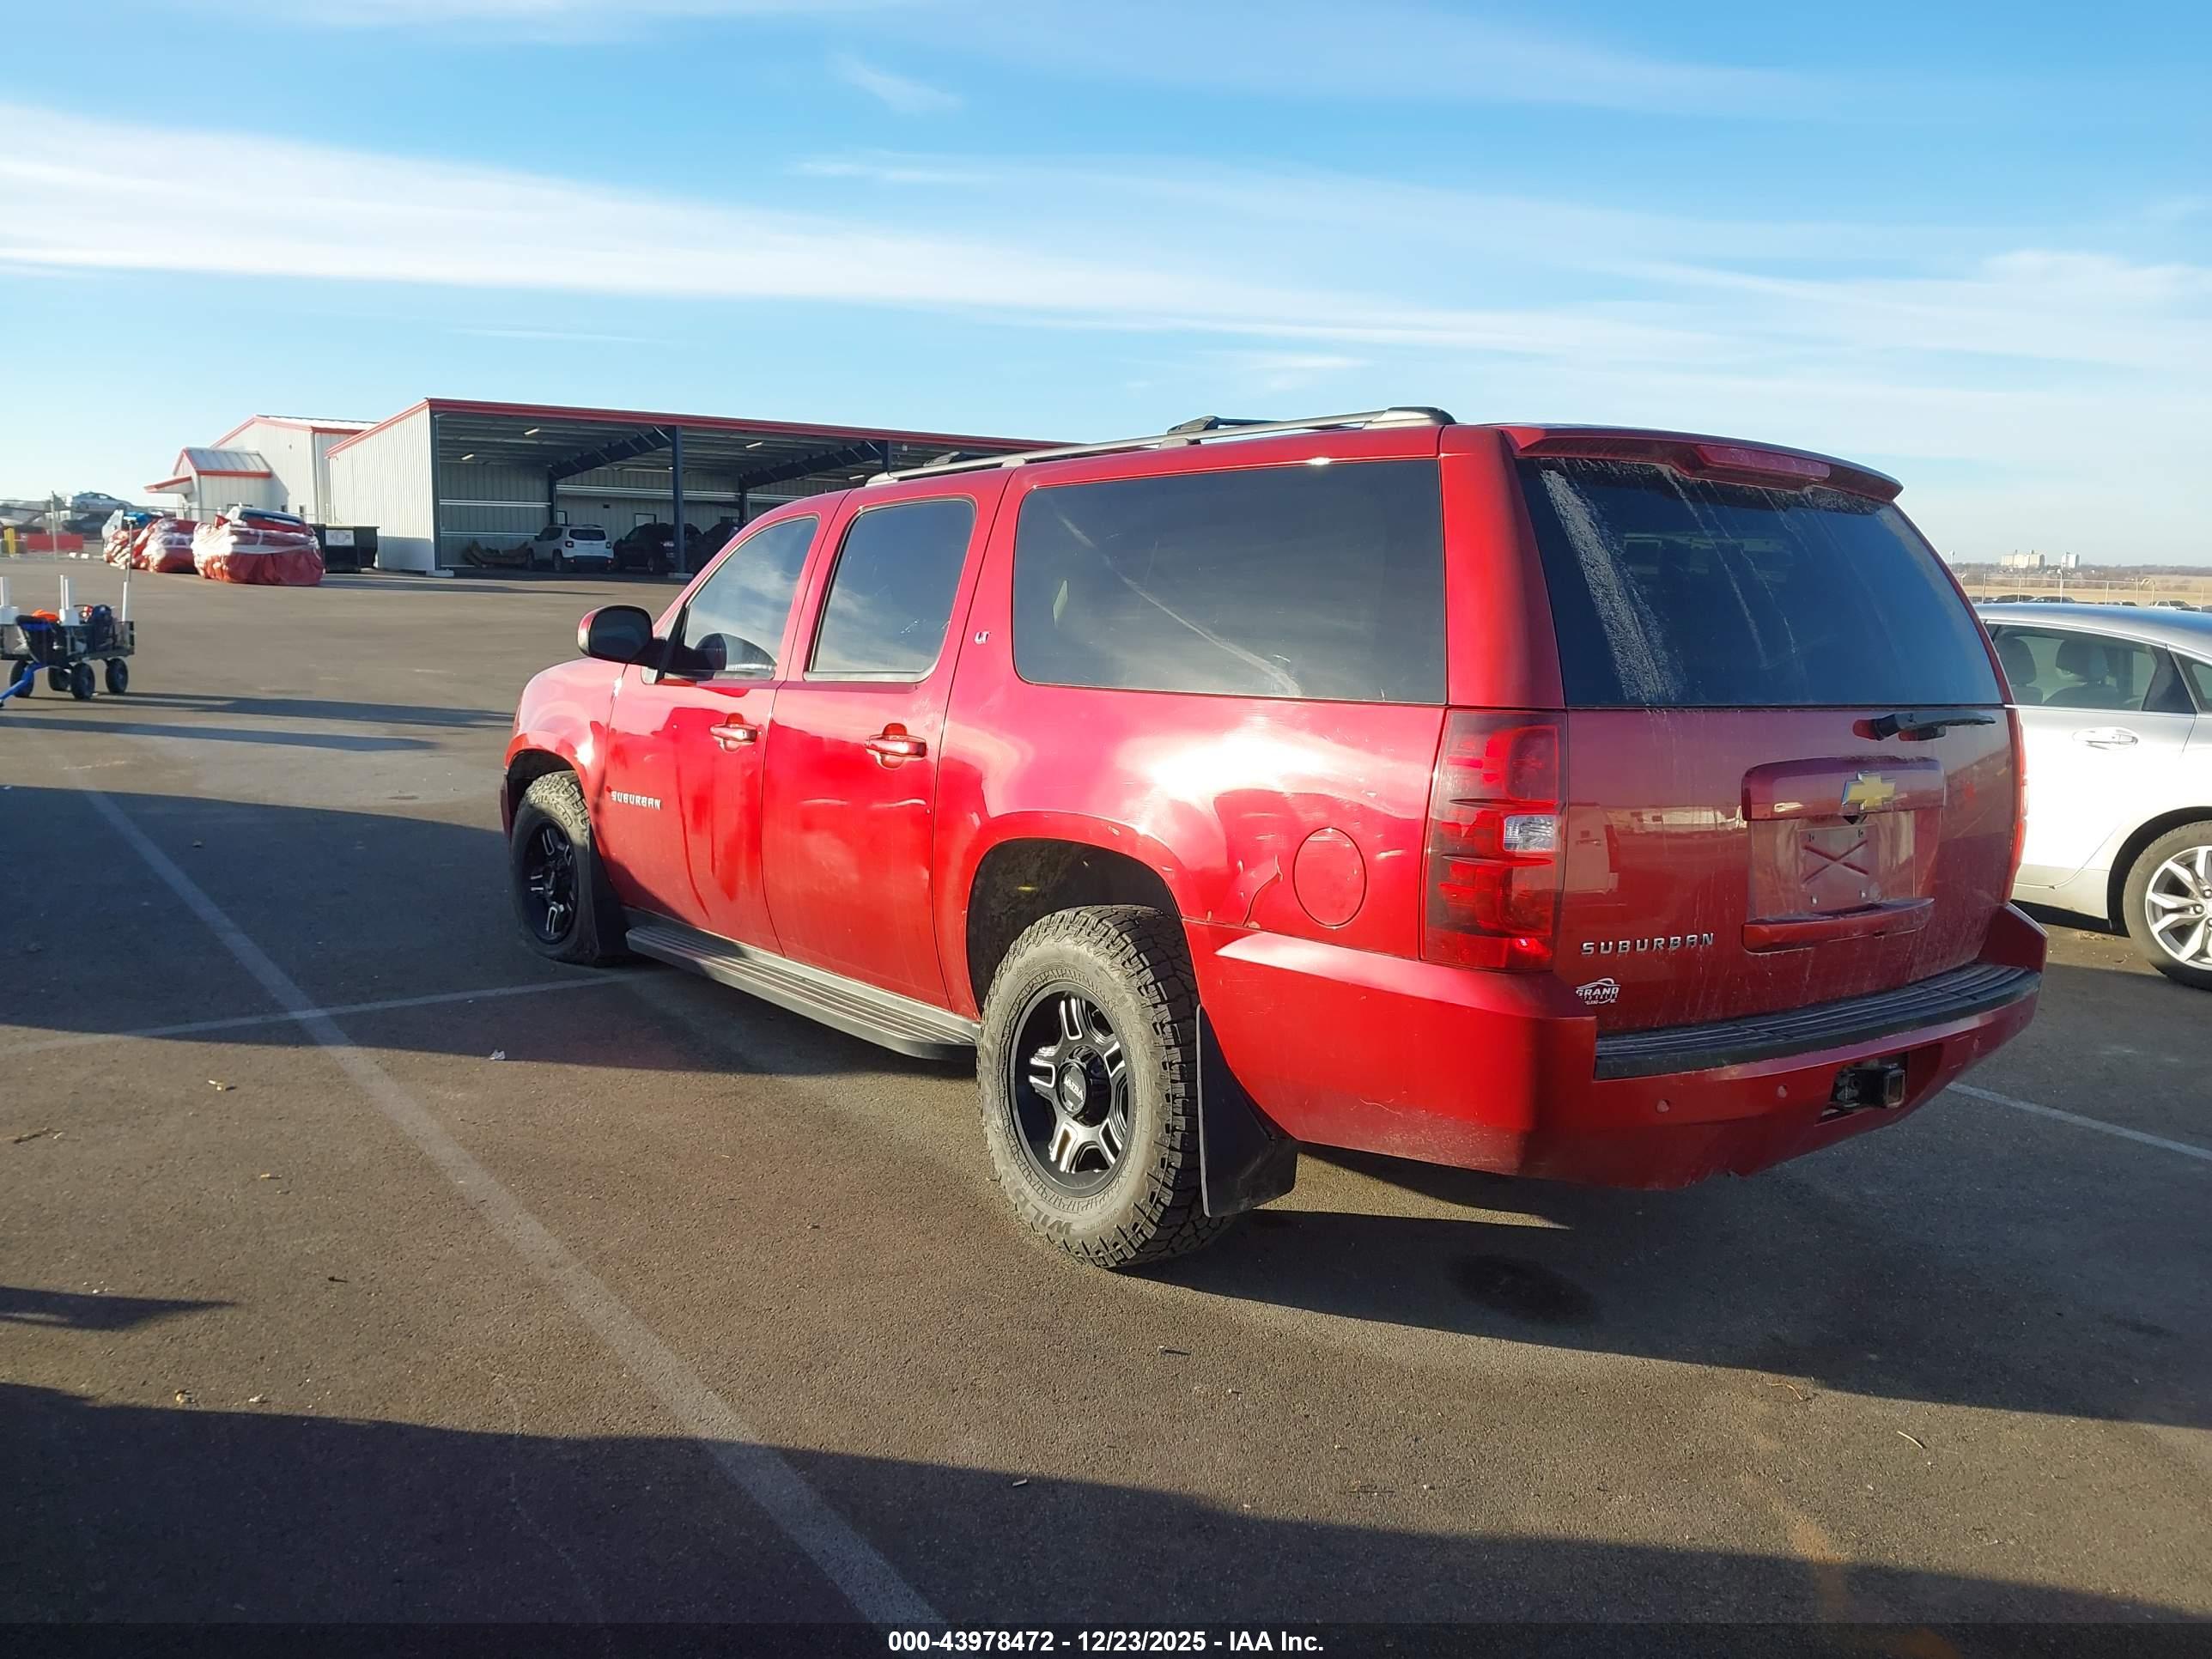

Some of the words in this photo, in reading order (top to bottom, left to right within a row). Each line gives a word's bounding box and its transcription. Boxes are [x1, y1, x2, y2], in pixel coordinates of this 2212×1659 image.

[611, 790, 661, 811] SUBURBAN
[1581, 933, 1714, 955] SUBURBAN
[1576, 987, 1620, 997] GRAND
